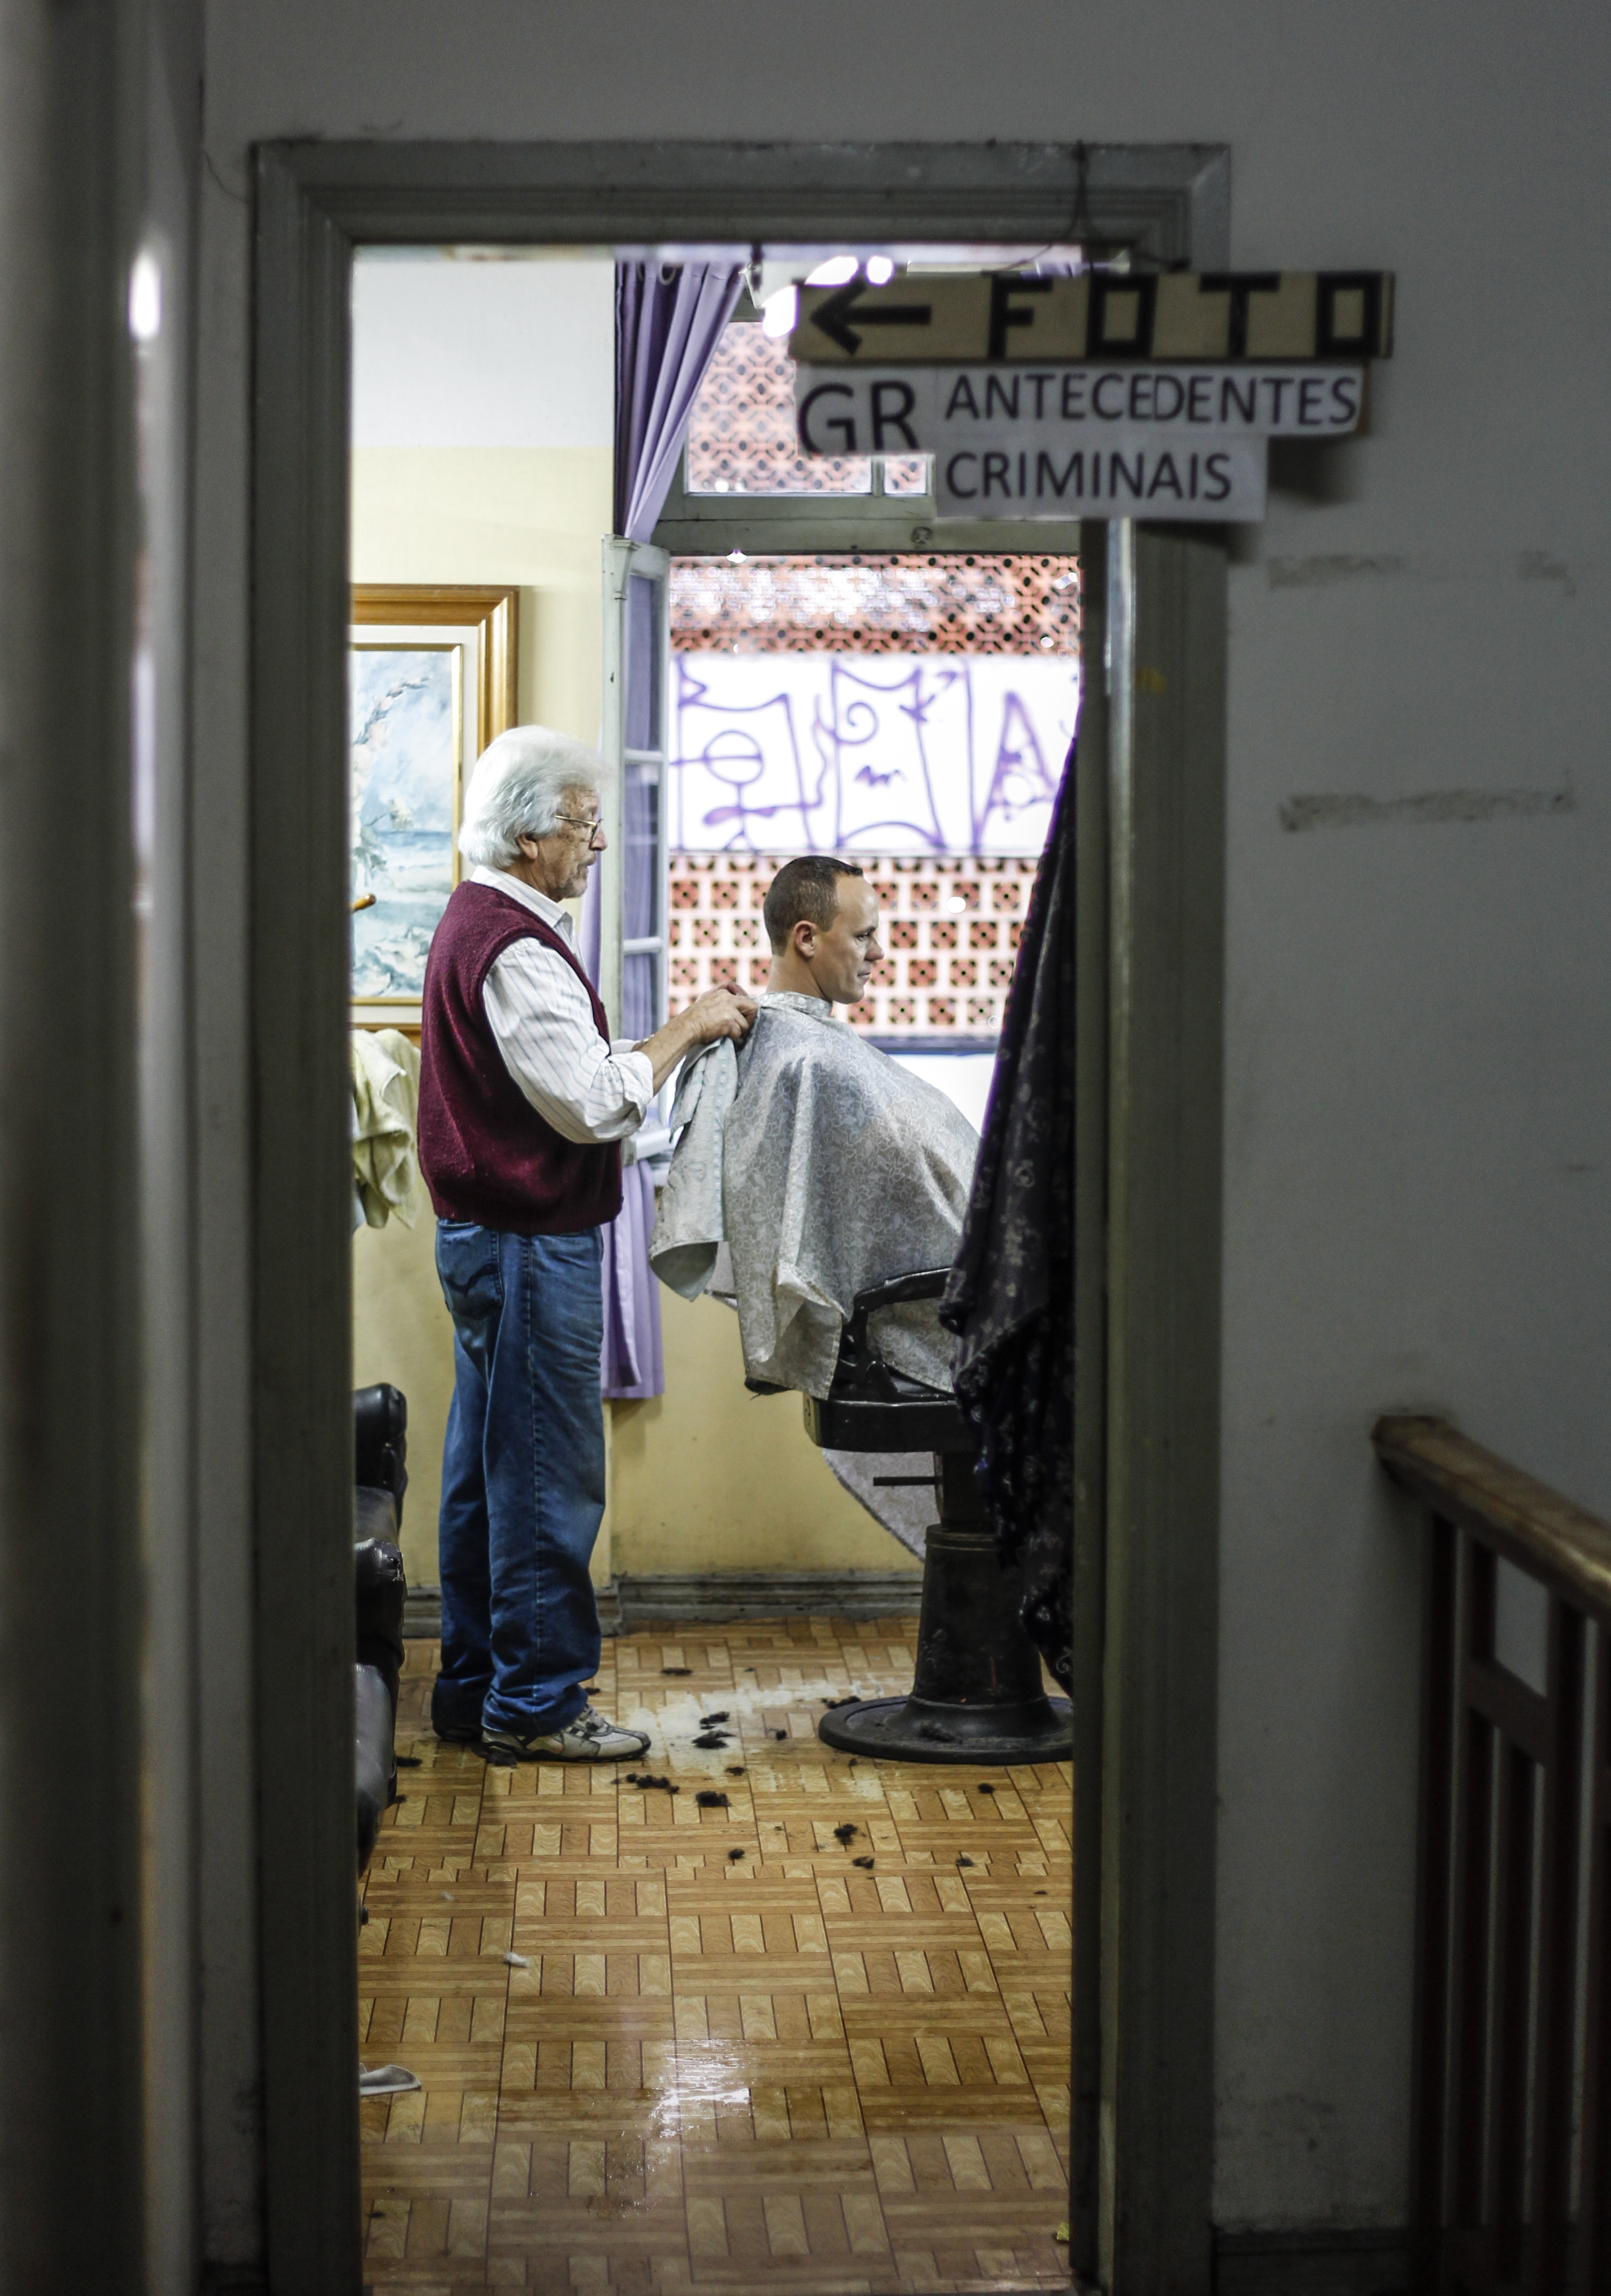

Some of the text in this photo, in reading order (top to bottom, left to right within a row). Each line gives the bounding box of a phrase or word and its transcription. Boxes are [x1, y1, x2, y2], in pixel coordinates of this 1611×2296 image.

[987, 272, 1380, 359] FOTO
[945, 373, 1357, 426] ANTECEDENTES
[946, 449, 1233, 501] CRIMINAIS
